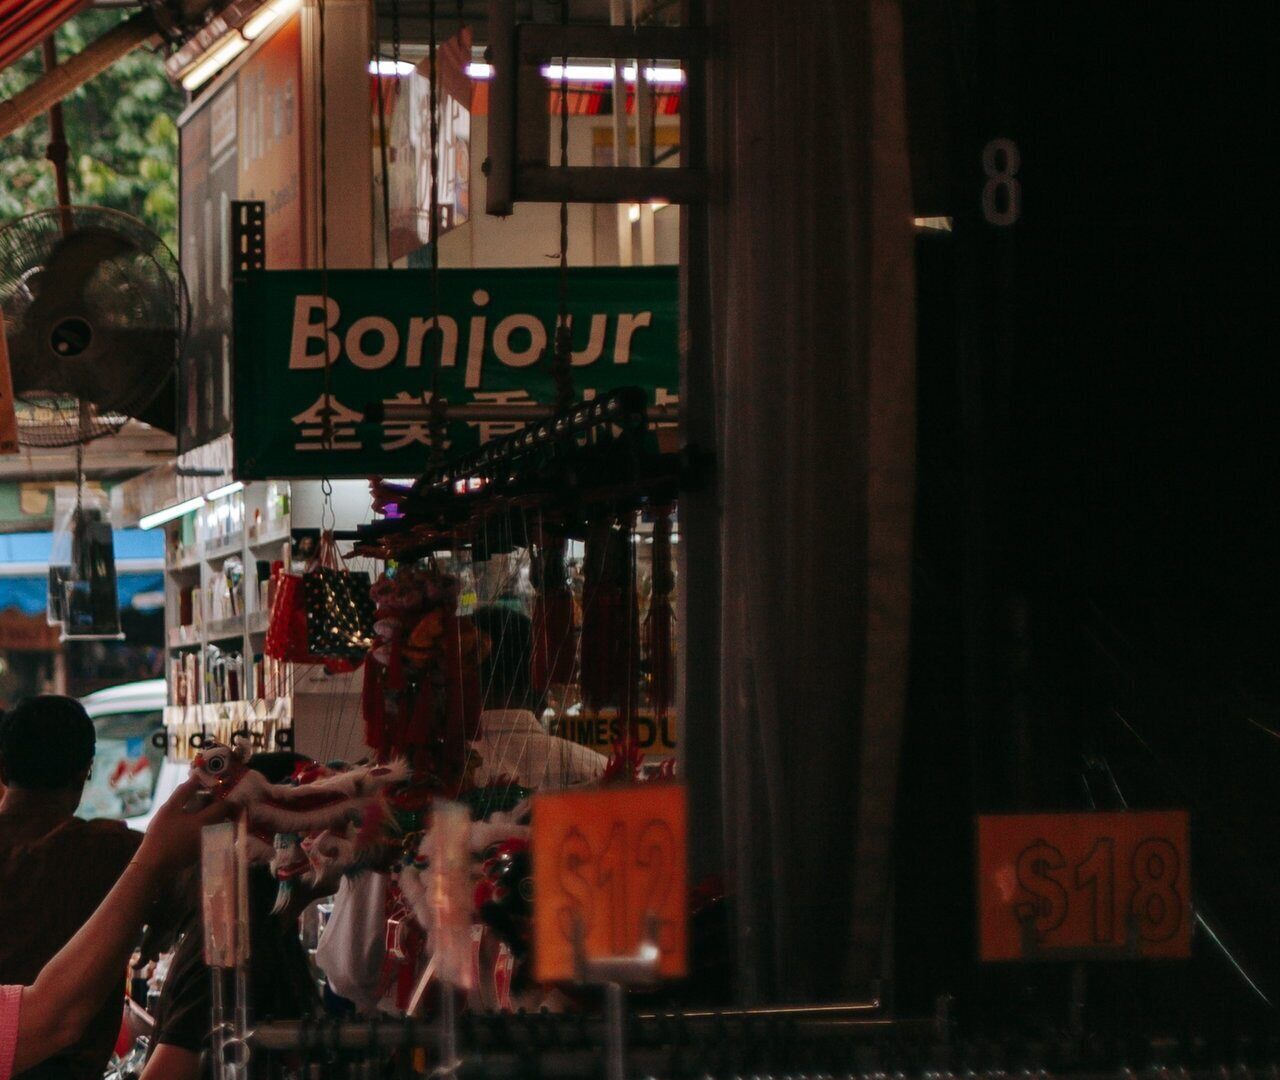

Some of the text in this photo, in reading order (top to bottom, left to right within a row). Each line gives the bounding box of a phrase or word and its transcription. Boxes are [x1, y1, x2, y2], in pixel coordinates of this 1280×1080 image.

[981, 135, 1022, 226] 8
[288, 288, 653, 389] Bonjour
[1013, 837, 1183, 944] $18
